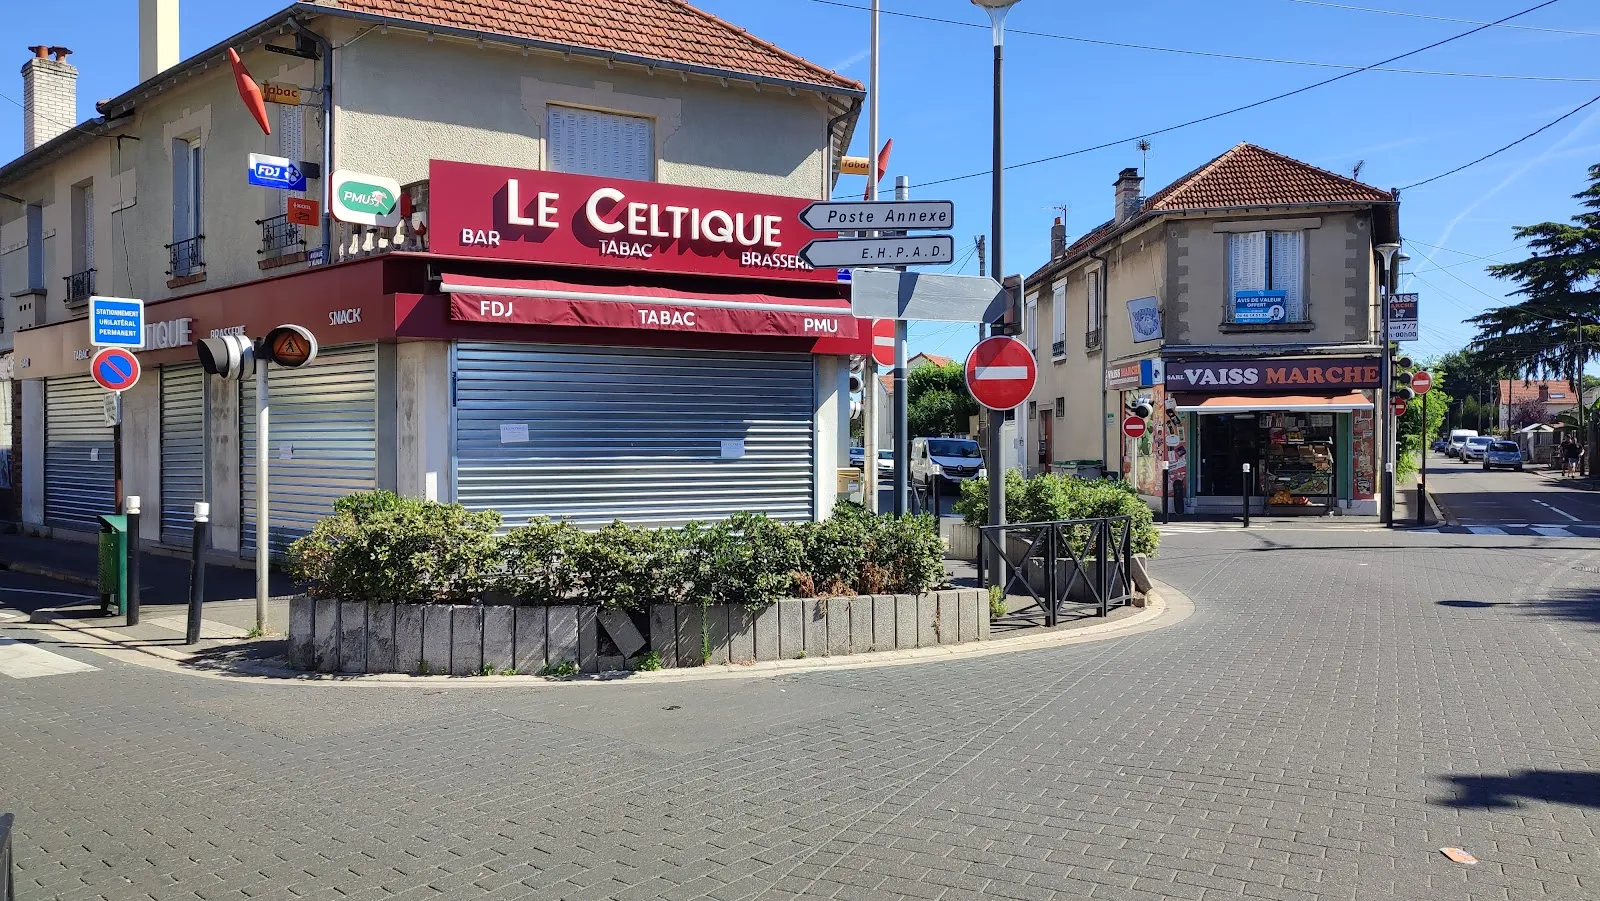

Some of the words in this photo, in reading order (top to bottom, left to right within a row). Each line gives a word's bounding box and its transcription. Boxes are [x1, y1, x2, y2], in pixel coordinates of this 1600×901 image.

[262, 82, 297, 98] Tabac
[257, 165, 281, 177] FDJ
[343, 190, 371, 205] PMU
[507, 178, 559, 229] LE
[585, 187, 782, 247] CELTIQUE
[827, 210, 874, 223] Poste
[884, 209, 947, 223] Annexe
[461, 229, 500, 246] BAR
[599, 239, 653, 258] TABAC
[861, 246, 946, 259] E.H.P.A.D.
[741, 251, 815, 270] BRASSER
[96, 308, 139, 317] STATIONNEMENT
[329, 307, 361, 326] SNACK
[480, 300, 513, 317] FDJ
[99, 318, 136, 327] UNILATÉRAL
[637, 309, 696, 326] TABAC
[804, 317, 838, 333] PMU
[99, 328, 137, 337] PERMANENT
[145, 318, 193, 350] TIQUE
[73, 349, 89, 361] TABAC
[1183, 367, 1259, 386] VAISS
[1265, 366, 1380, 385] MARCHE
